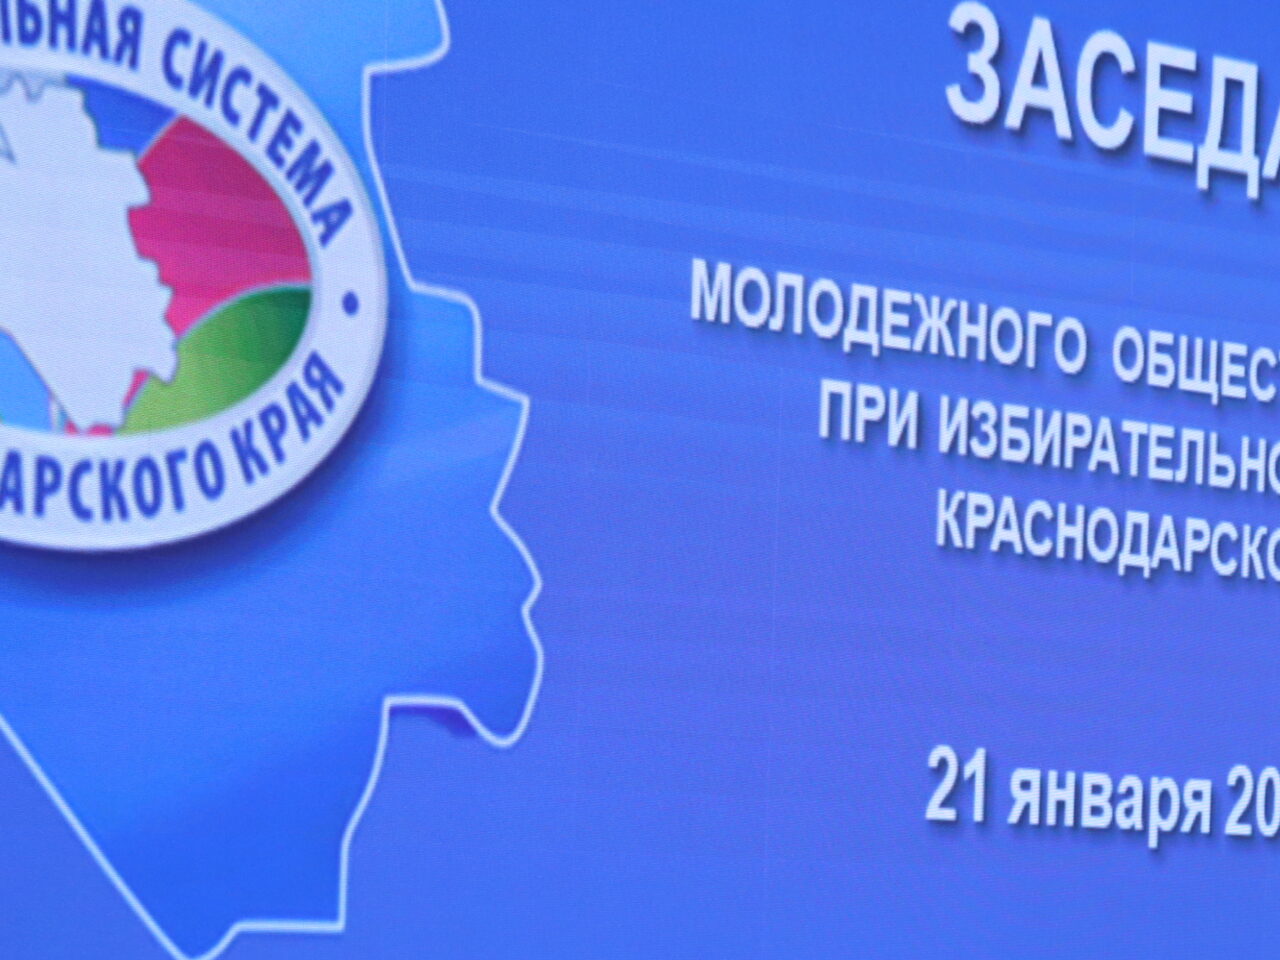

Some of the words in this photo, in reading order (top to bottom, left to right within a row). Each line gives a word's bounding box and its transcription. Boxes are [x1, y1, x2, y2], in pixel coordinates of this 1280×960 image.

[161, 27, 354, 248] СИСТЕМА
[690, 258, 1088, 375] МОЛОДЕЖНОГО
[229, 350, 345, 485] КРАЯ
[818, 378, 920, 449] ПРИ
[924, 744, 989, 823] 21
[1006, 766, 1213, 850] января
